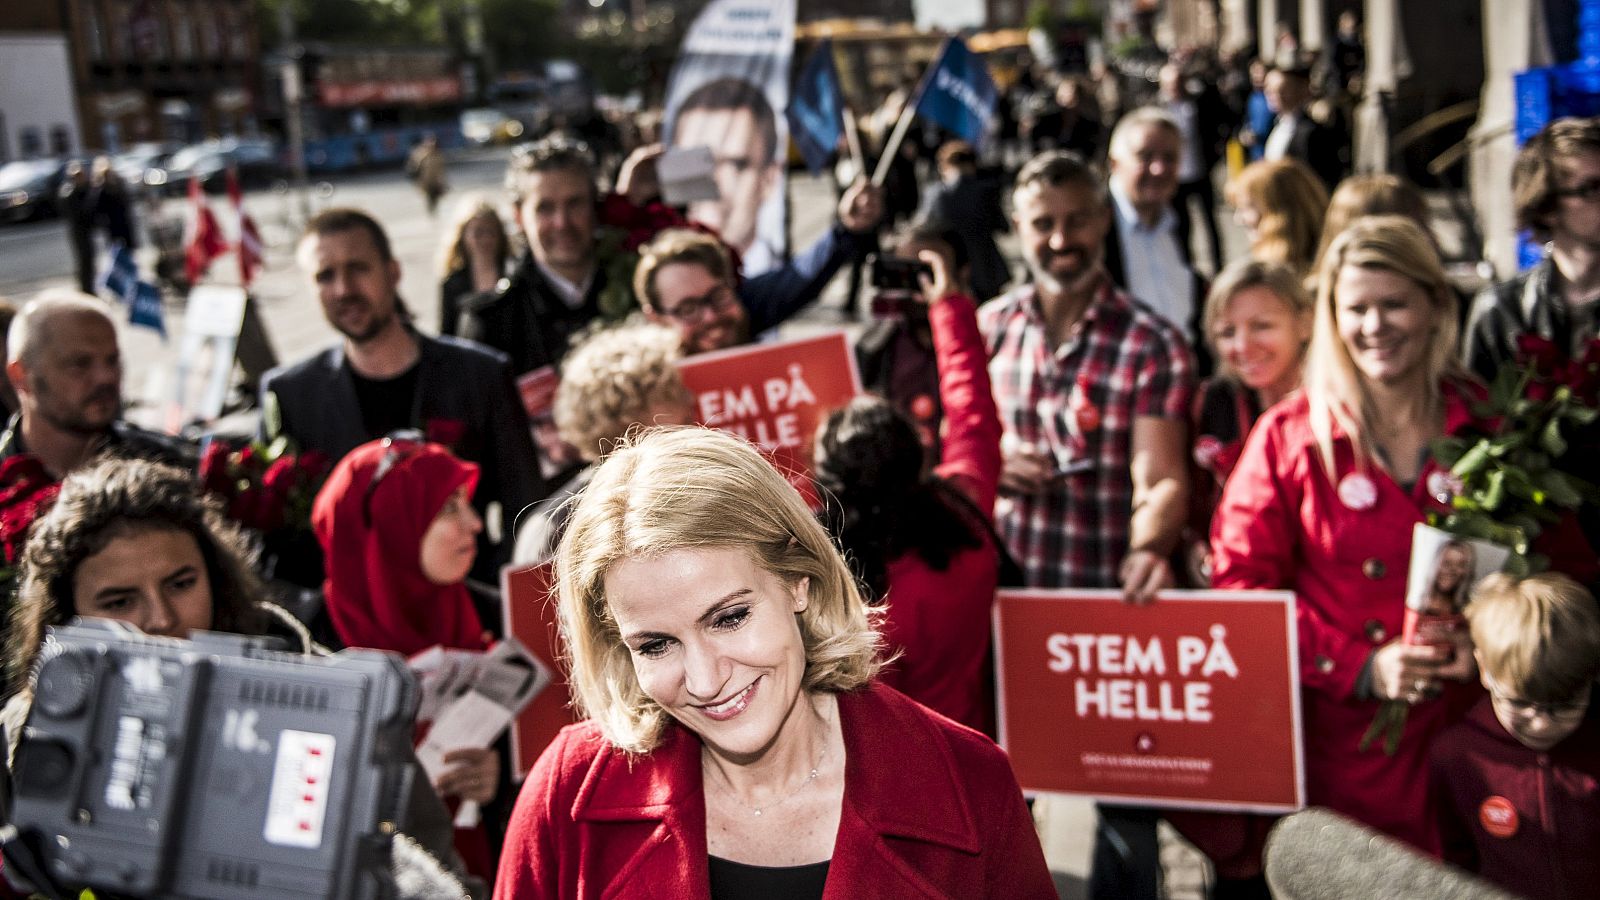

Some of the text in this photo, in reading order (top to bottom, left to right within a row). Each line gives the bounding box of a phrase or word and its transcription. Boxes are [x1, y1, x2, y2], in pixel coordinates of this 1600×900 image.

[698, 363, 817, 425] EM PÅ
[1046, 624, 1239, 678] STEM PÅ
[1074, 678, 1214, 722] HELLE
